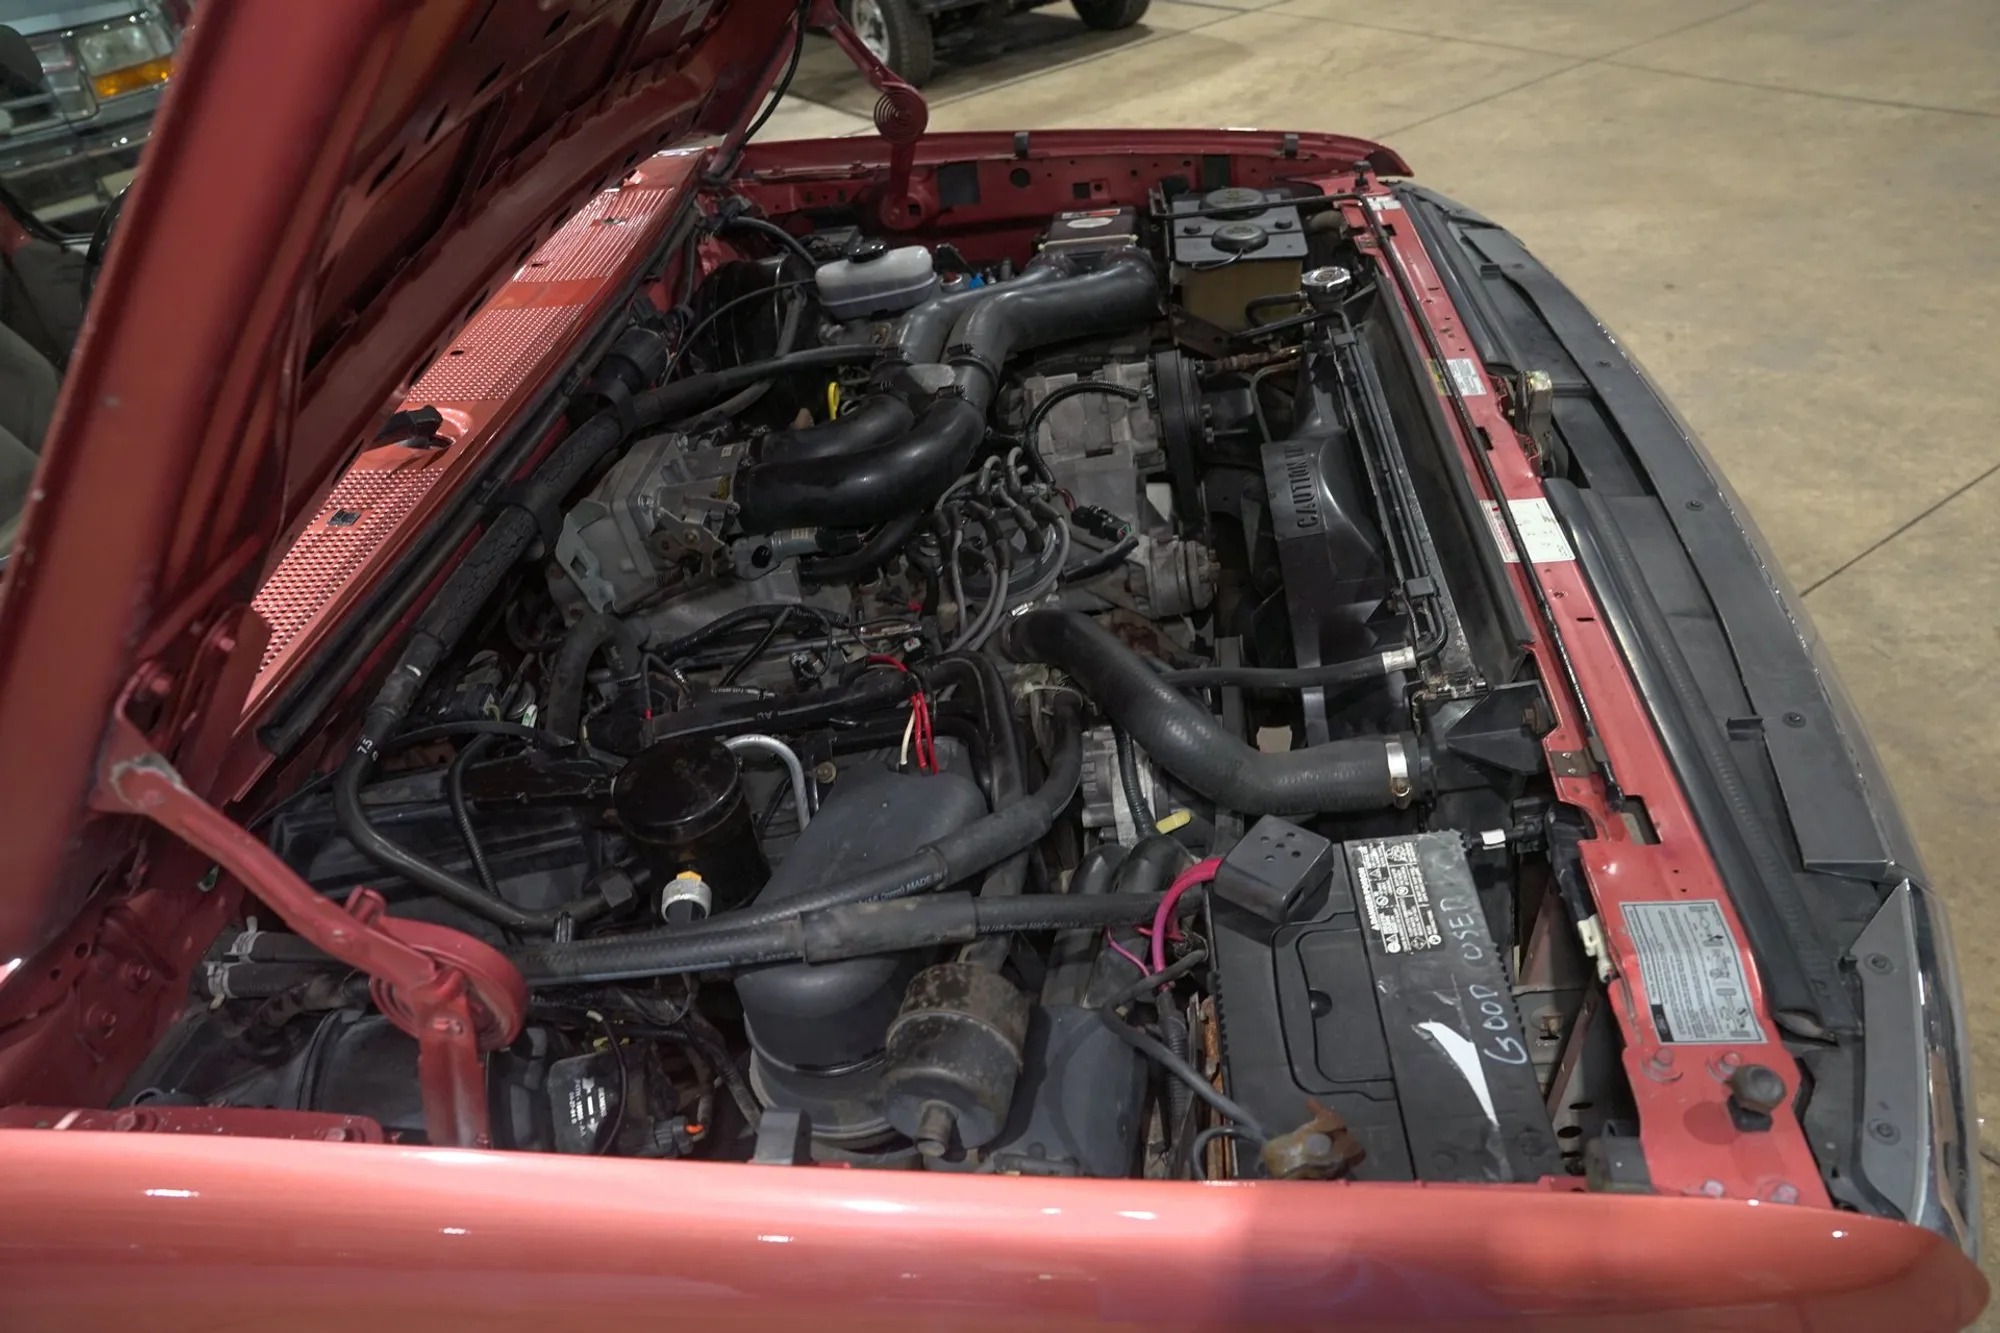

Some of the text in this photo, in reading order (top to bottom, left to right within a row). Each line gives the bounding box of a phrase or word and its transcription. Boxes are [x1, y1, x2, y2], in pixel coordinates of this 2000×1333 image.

[1286, 461, 1319, 529] CAUTION
[1438, 897, 1528, 1065] GOOD USED
